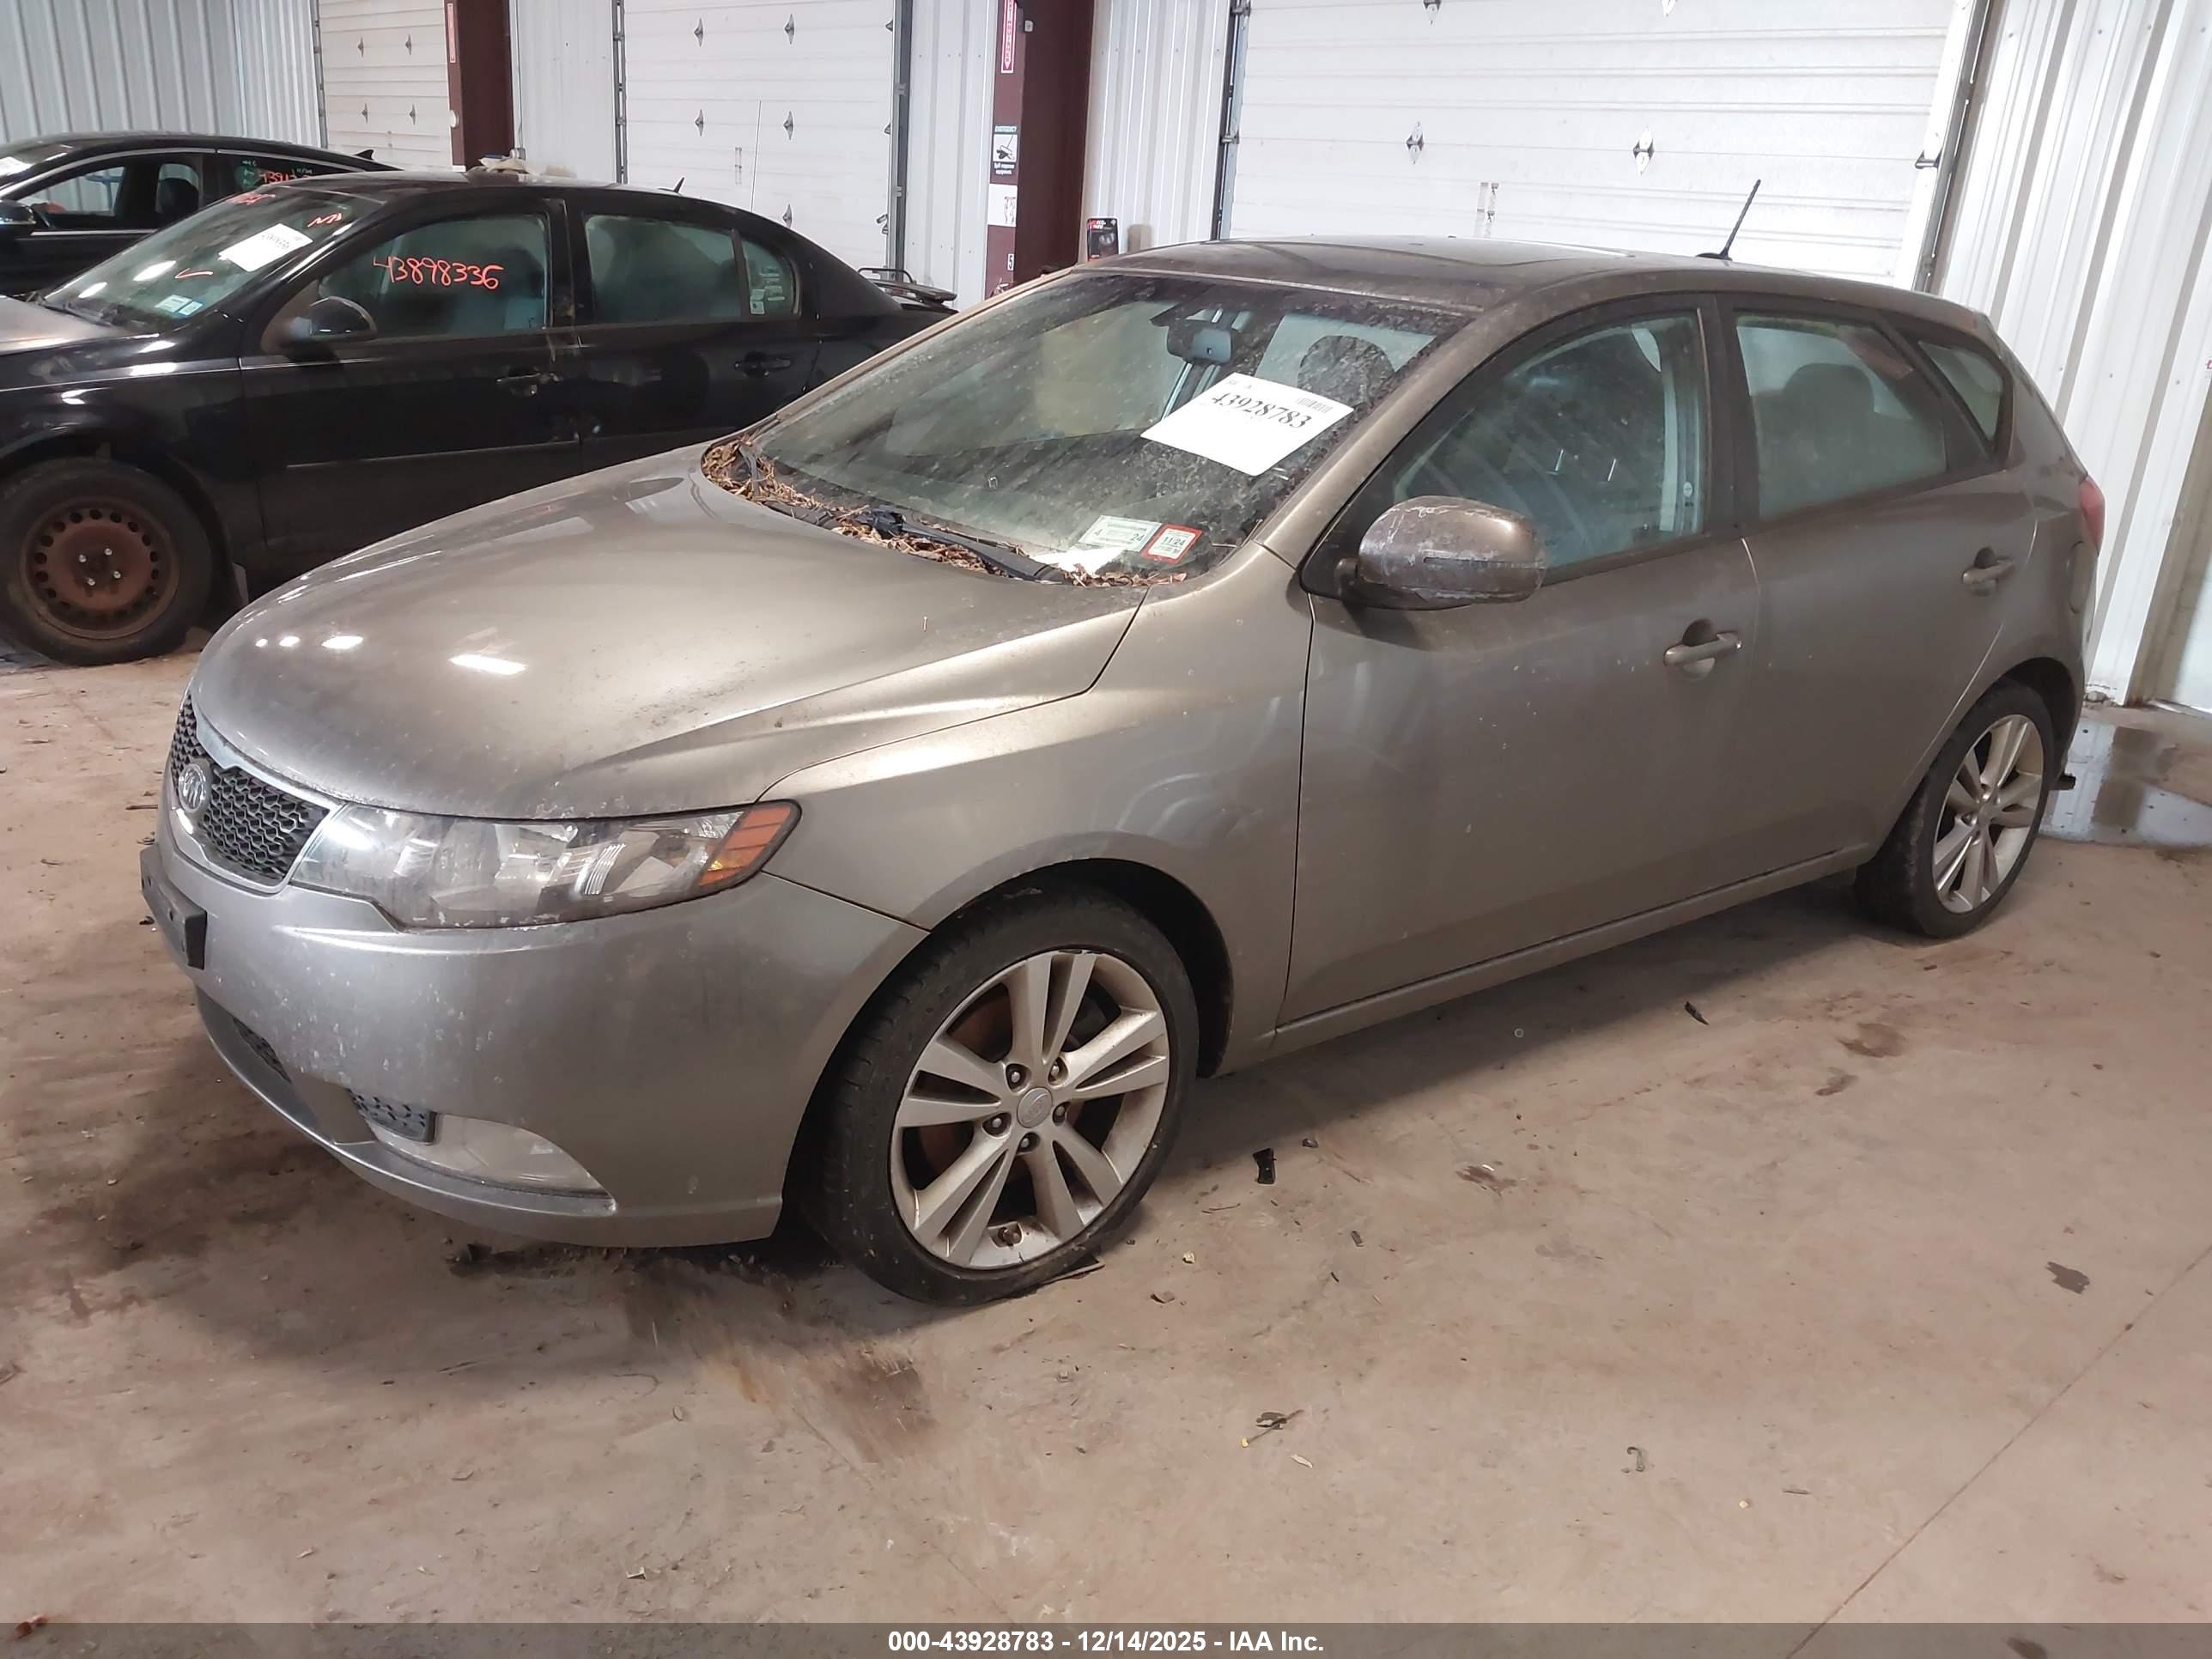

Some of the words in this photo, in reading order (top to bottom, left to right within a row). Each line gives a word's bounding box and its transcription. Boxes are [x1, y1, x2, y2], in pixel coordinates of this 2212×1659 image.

[373, 255, 505, 290] 43898336
[1008, 255, 1013, 269] 5
[1212, 392, 1312, 428] 43928783
